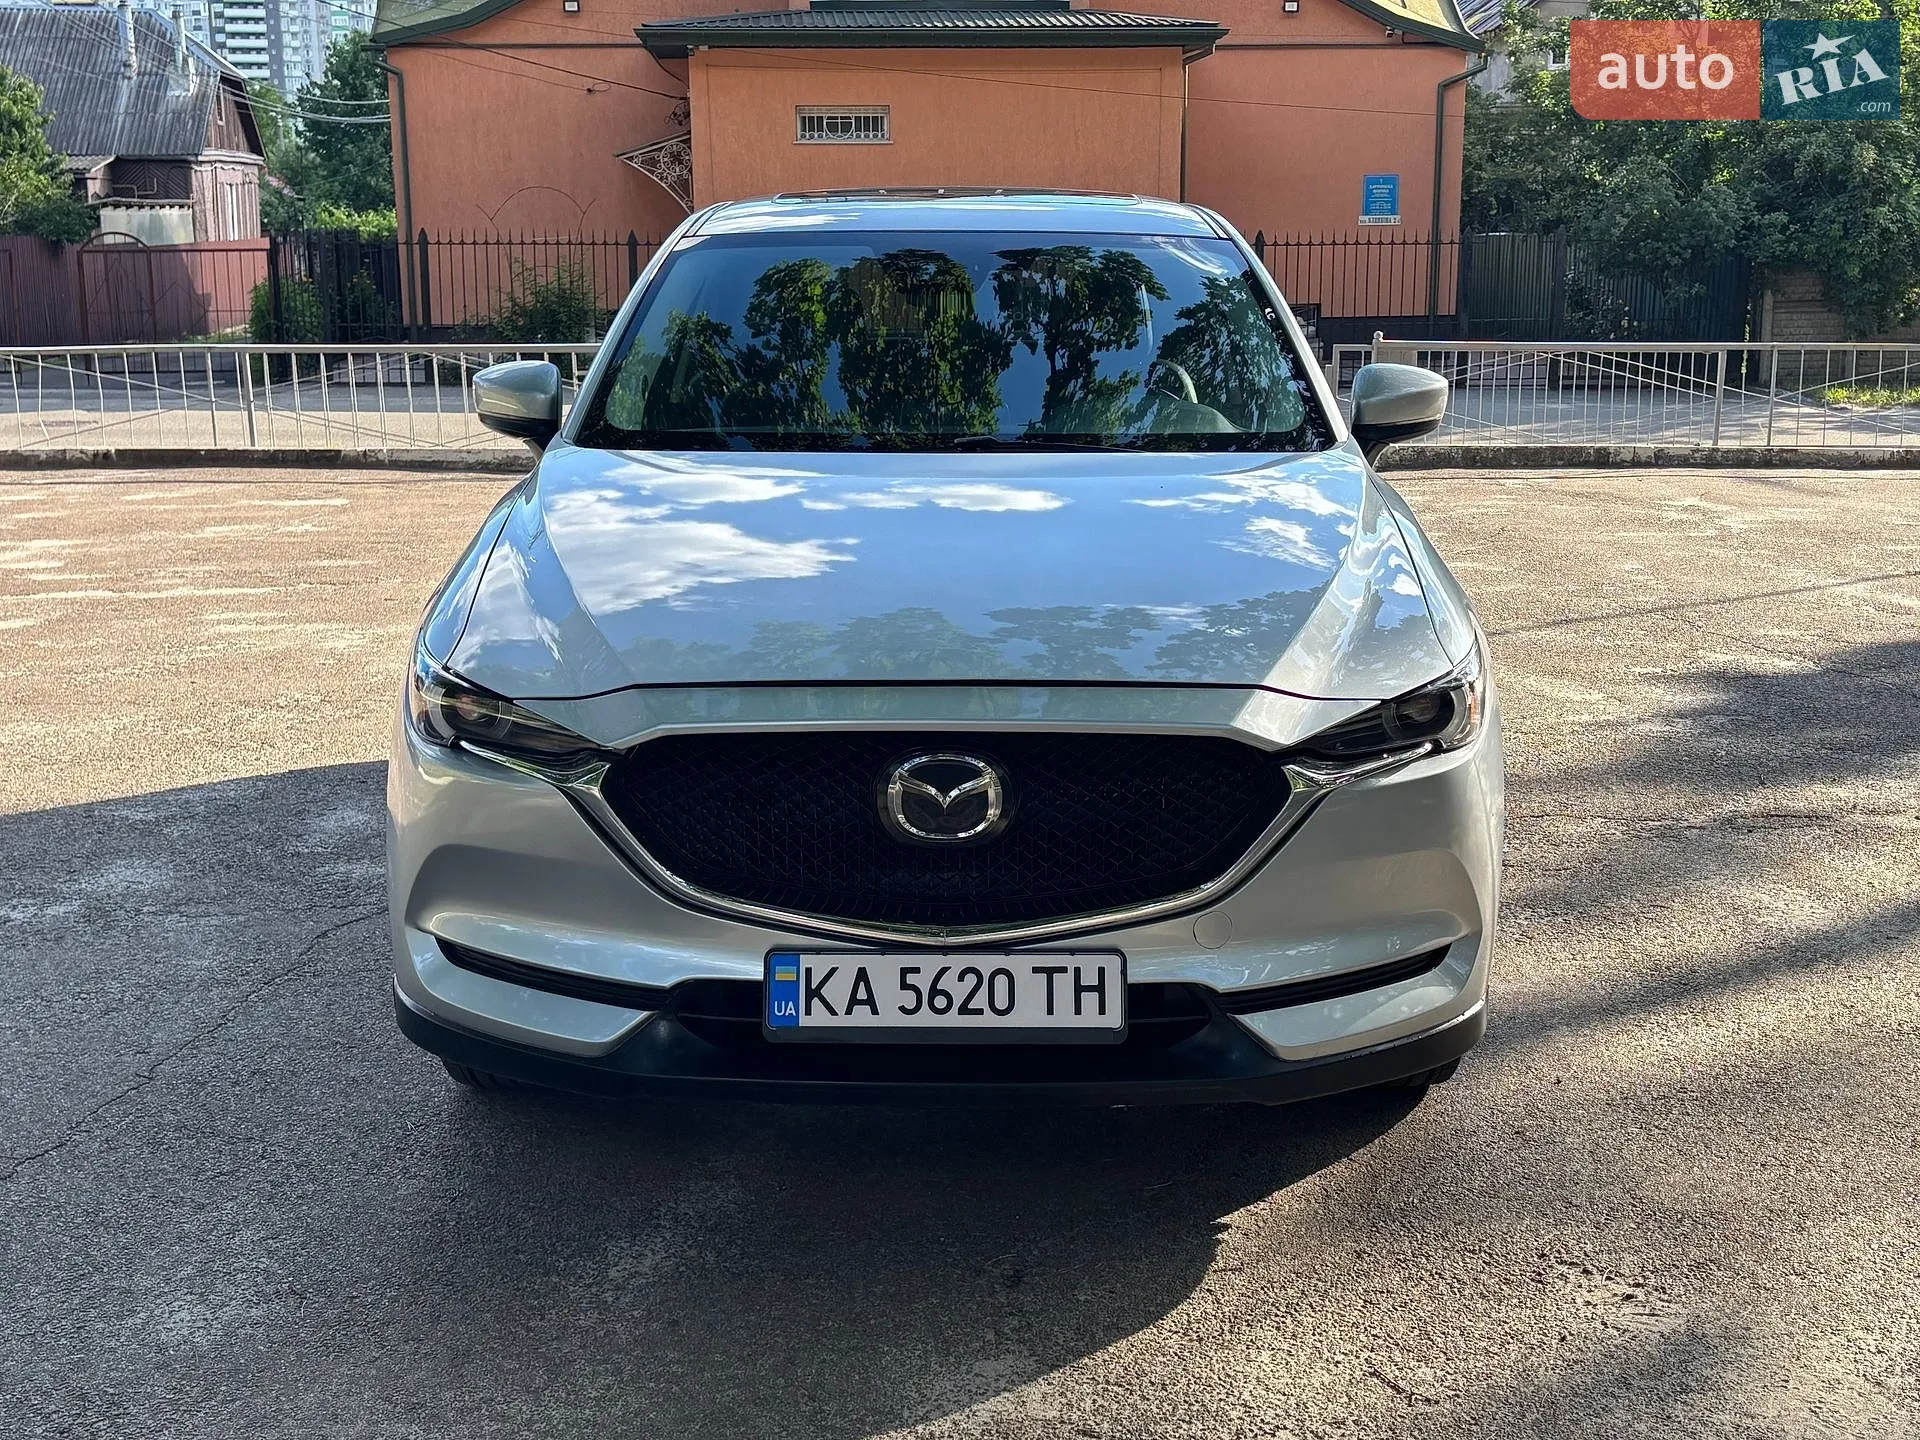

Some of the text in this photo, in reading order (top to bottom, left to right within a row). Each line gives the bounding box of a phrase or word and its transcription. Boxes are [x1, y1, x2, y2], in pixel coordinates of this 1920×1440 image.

[803, 966, 1107, 1017] KA 5620 TH
[774, 1003, 796, 1017] UA
